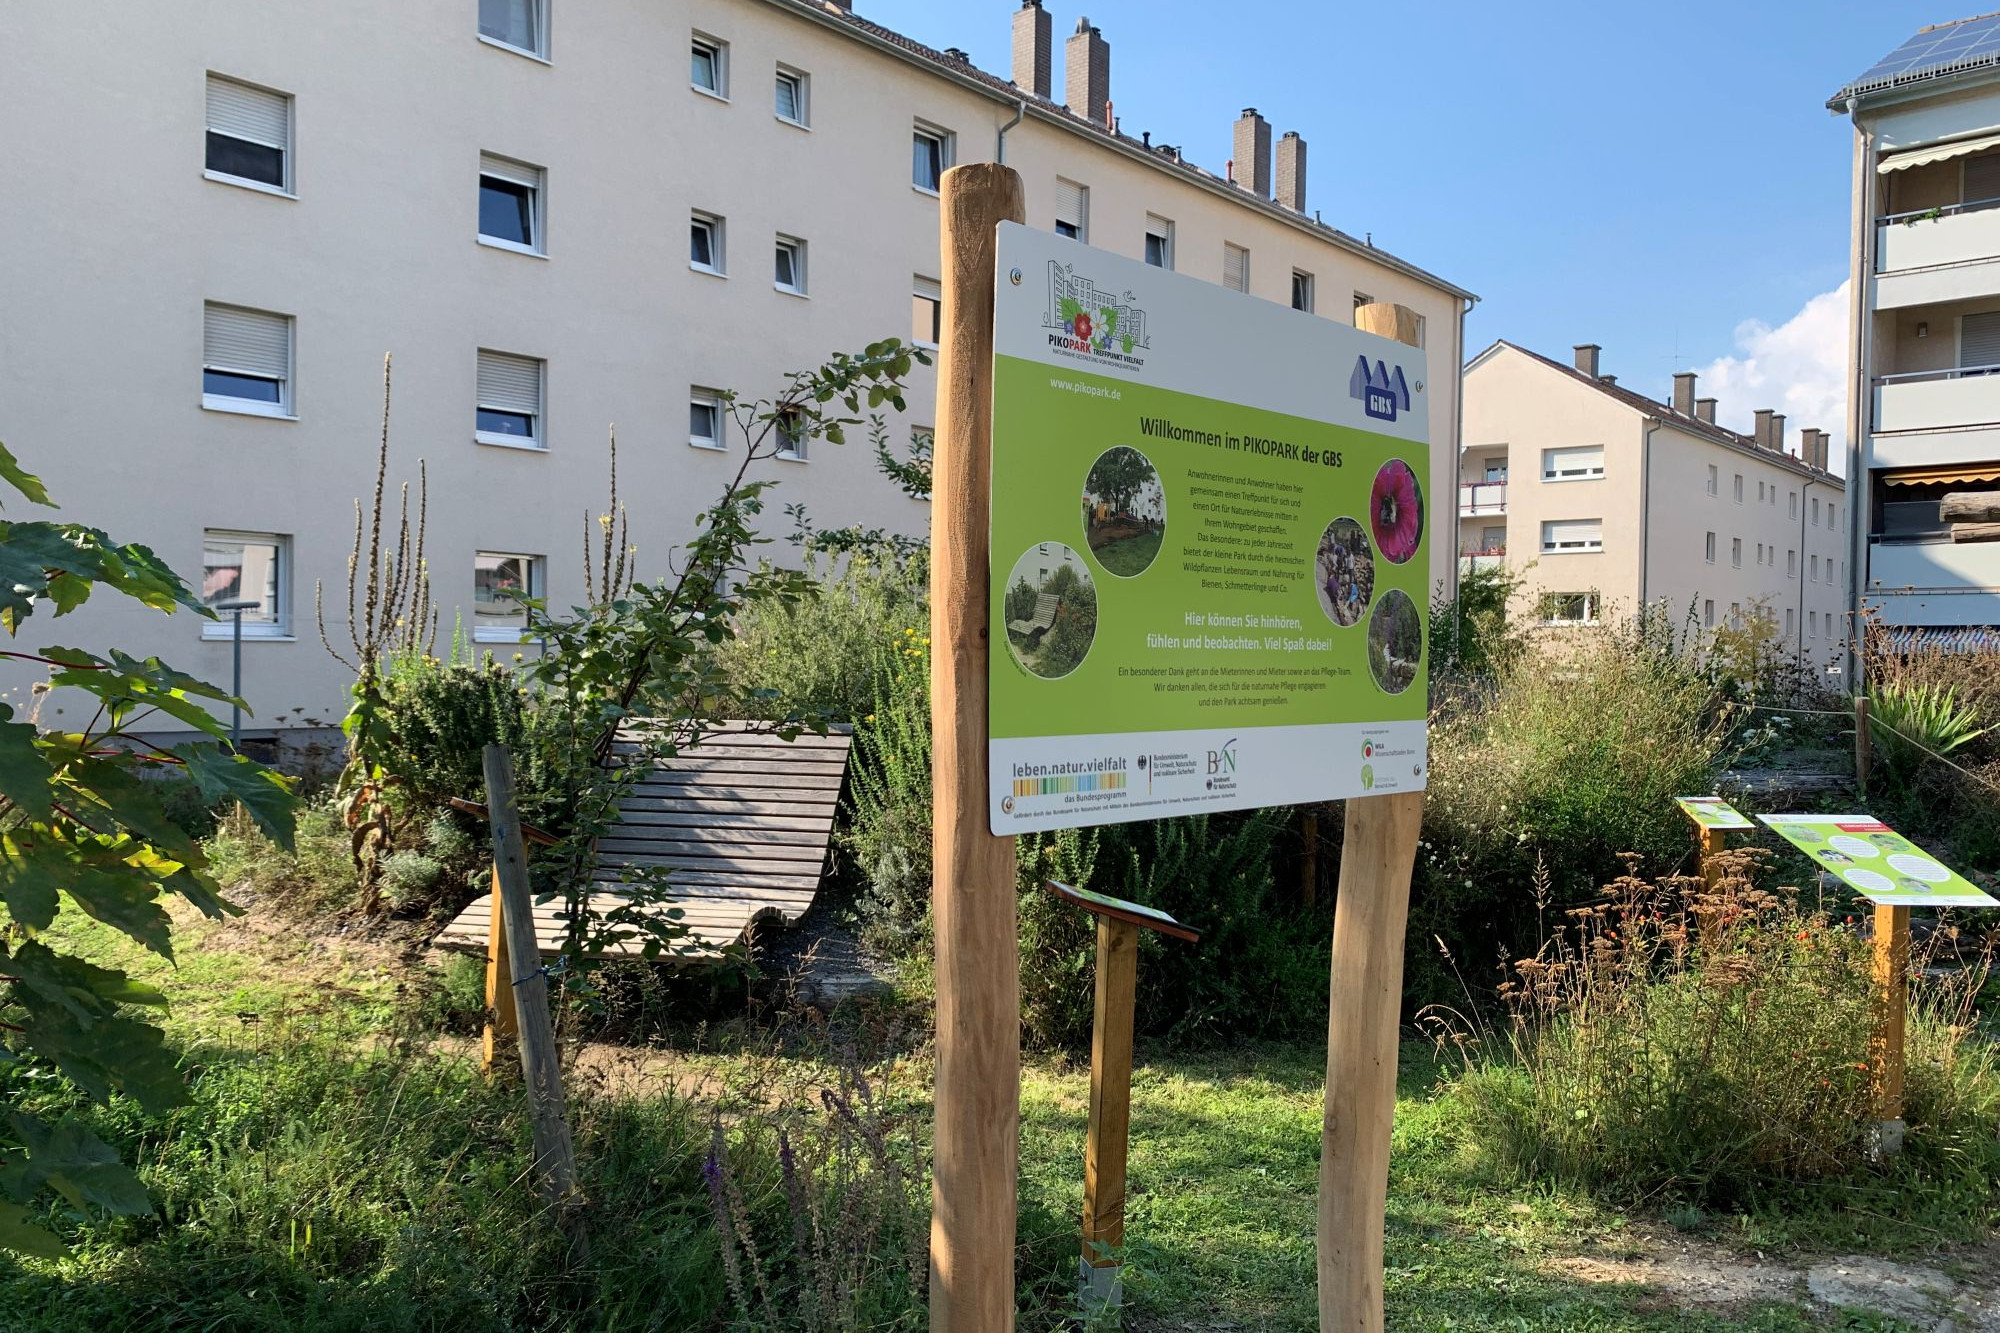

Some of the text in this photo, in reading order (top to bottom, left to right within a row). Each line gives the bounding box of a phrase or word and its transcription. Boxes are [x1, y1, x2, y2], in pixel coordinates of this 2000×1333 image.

[1049, 334, 1091, 354] PIKOPARK
[1093, 349, 1144, 365] TREFFPUNKT VIELFALT
[1050, 379, 1121, 400] www.pikopark.de
[1370, 395, 1392, 414] GBS
[1140, 417, 1342, 468] Willkommen im PIKOPARK der GBS
[1188, 468, 1303, 493] Anwohnerinnen und Anwohner haben hier
[1190, 486, 1223, 497] gemeinsam
[1225, 491, 1240, 499] einen
[1242, 492, 1269, 503] Treffpunkt
[1193, 501, 1209, 511] einen
[1211, 503, 1220, 512] Ort
[1222, 504, 1230, 513] für
[1232, 506, 1274, 519] Naturerlebnisse
[1275, 512, 1293, 521] mitten
[1205, 518, 1287, 534] Ihrem Wohngebiet geschaffen.
[1198, 533, 1208, 541] Das
[1210, 534, 1242, 544] Besondere:
[1251, 538, 1265, 548] jeder
[1267, 539, 1293, 549] Jahreszeit
[1184, 547, 1304, 565] bietet der kleine Park durch die heimischen
[1183, 562, 1222, 573] Wildpflanzen
[1224, 565, 1258, 576] Lebensraum
[1260, 568, 1270, 577] und
[1273, 569, 1295, 580] Nahrung
[1202, 579, 1223, 590] Bienen,
[1225, 581, 1267, 593] Schmetterlinge
[1268, 583, 1278, 592] und
[1185, 612, 1302, 631] Hier können Sie hinhören,
[1147, 634, 1332, 652] fühlen und beobachten. Viel Spaß dabei!
[1119, 667, 1128, 676] Ein
[1130, 667, 1167, 676] besonderer
[1169, 667, 1184, 676] Dank
[1186, 668, 1199, 677] geht
[1210, 667, 1219, 675] die
[1220, 668, 1255, 676] Mieterinnen
[1257, 667, 1267, 675] und
[1154, 683, 1165, 692] Wir
[1167, 683, 1189, 692] danken
[1191, 683, 1207, 692] allen,
[1209, 682, 1217, 691] die
[1220, 682, 1230, 691] sich
[1232, 682, 1240, 690] für
[1241, 682, 1250, 690] die
[1281, 681, 1297, 691] Pflege
[1212, 698, 1222, 706] den
[1224, 697, 1236, 705] Park
[1013, 757, 1126, 777] leben.natur.vielfalt
[1065, 792, 1126, 803] das Bundesprogramm
